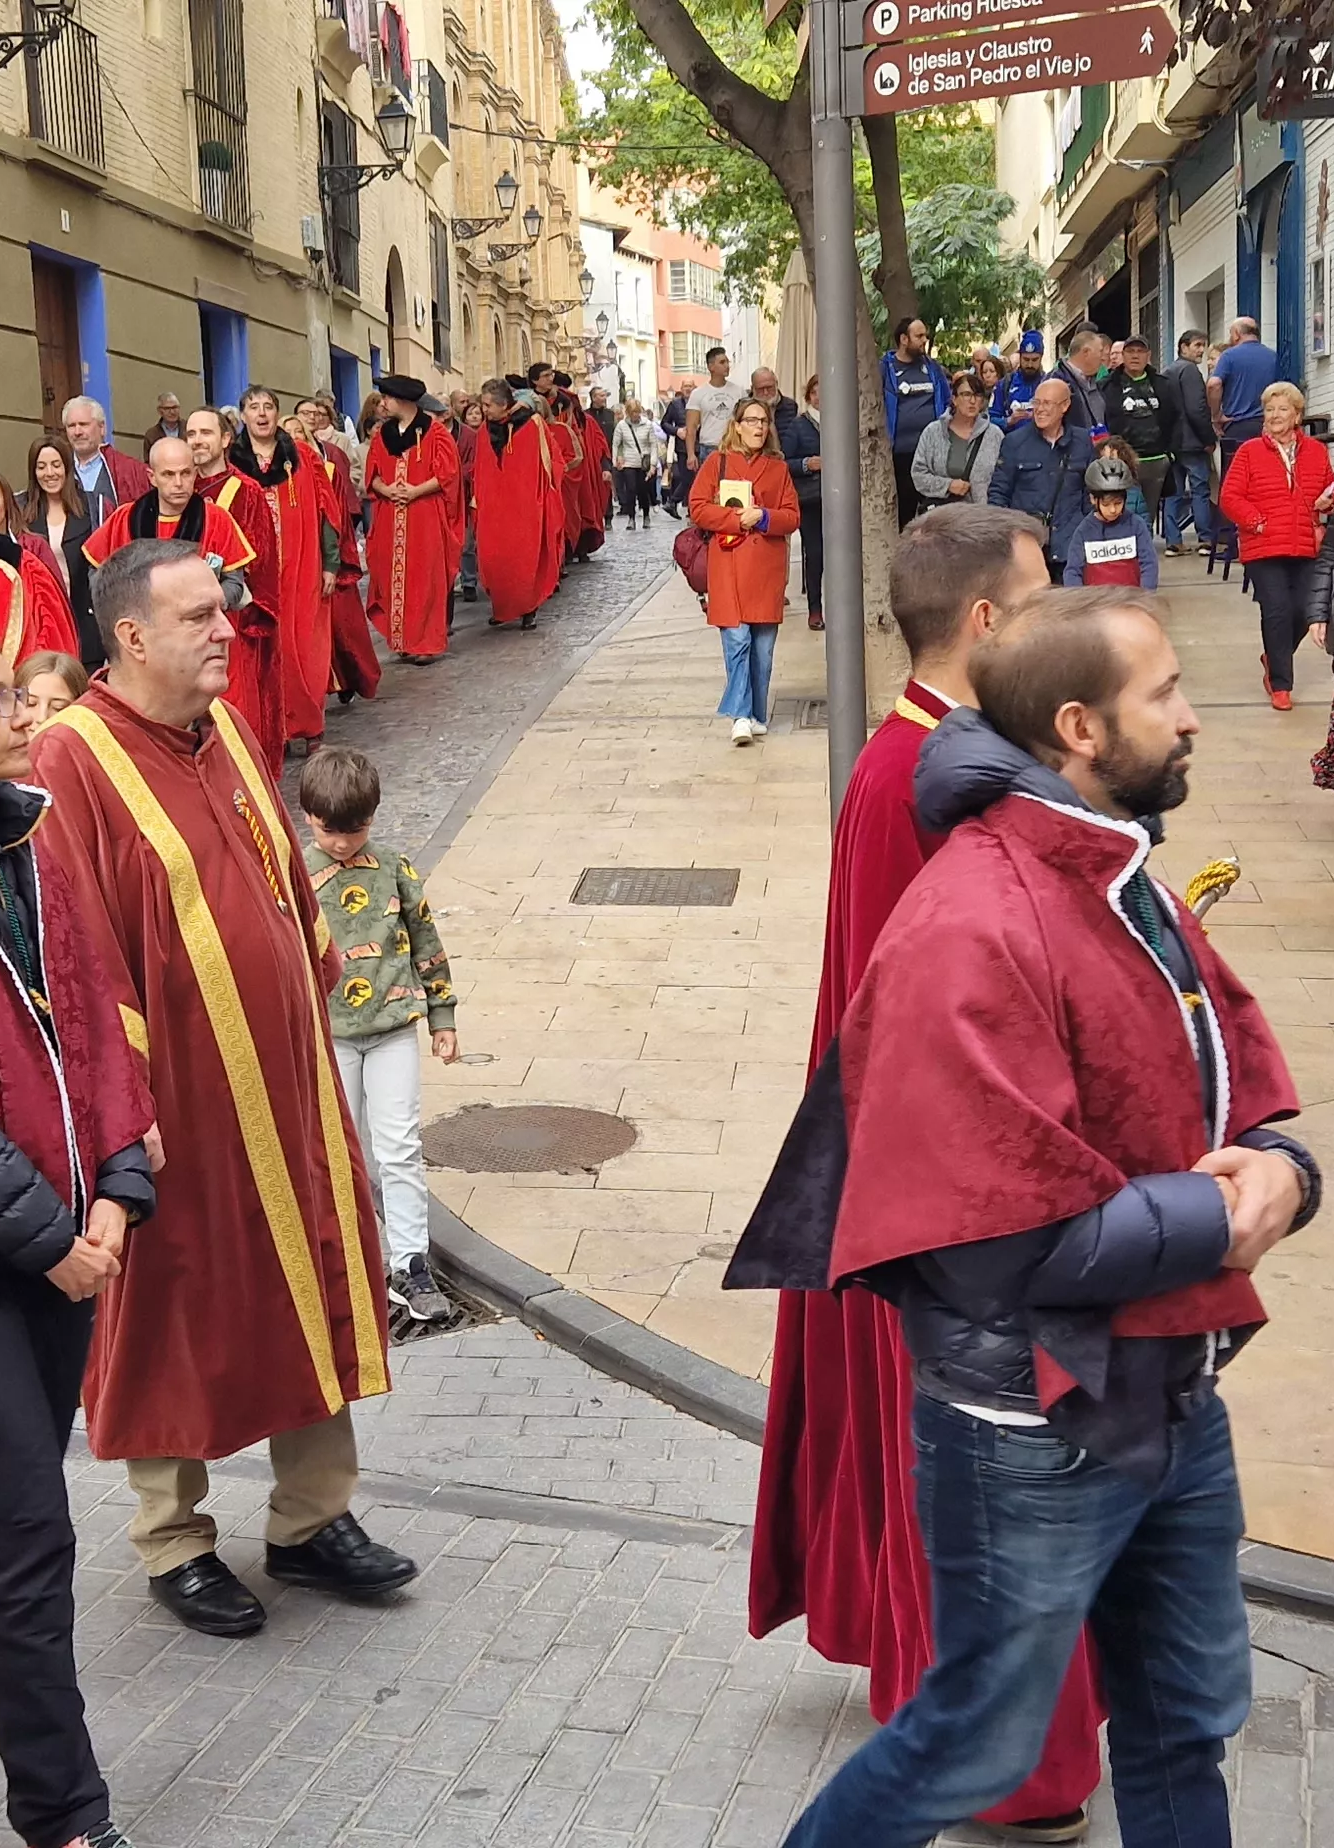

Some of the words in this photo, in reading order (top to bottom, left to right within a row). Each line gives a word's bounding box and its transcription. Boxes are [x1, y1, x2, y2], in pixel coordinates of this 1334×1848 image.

[881, 8, 893, 29] P
[908, 1, 972, 24] Parking
[908, 49, 962, 75] Iglesia
[965, 49, 976, 68] y
[979, 37, 1052, 61] Claustro
[908, 77, 929, 95] de
[933, 73, 965, 91] San
[971, 63, 1021, 87] Pedro
[1026, 60, 1040, 78] el
[1045, 53, 1091, 76] Viejo
[1091, 543, 1133, 559] adidas
